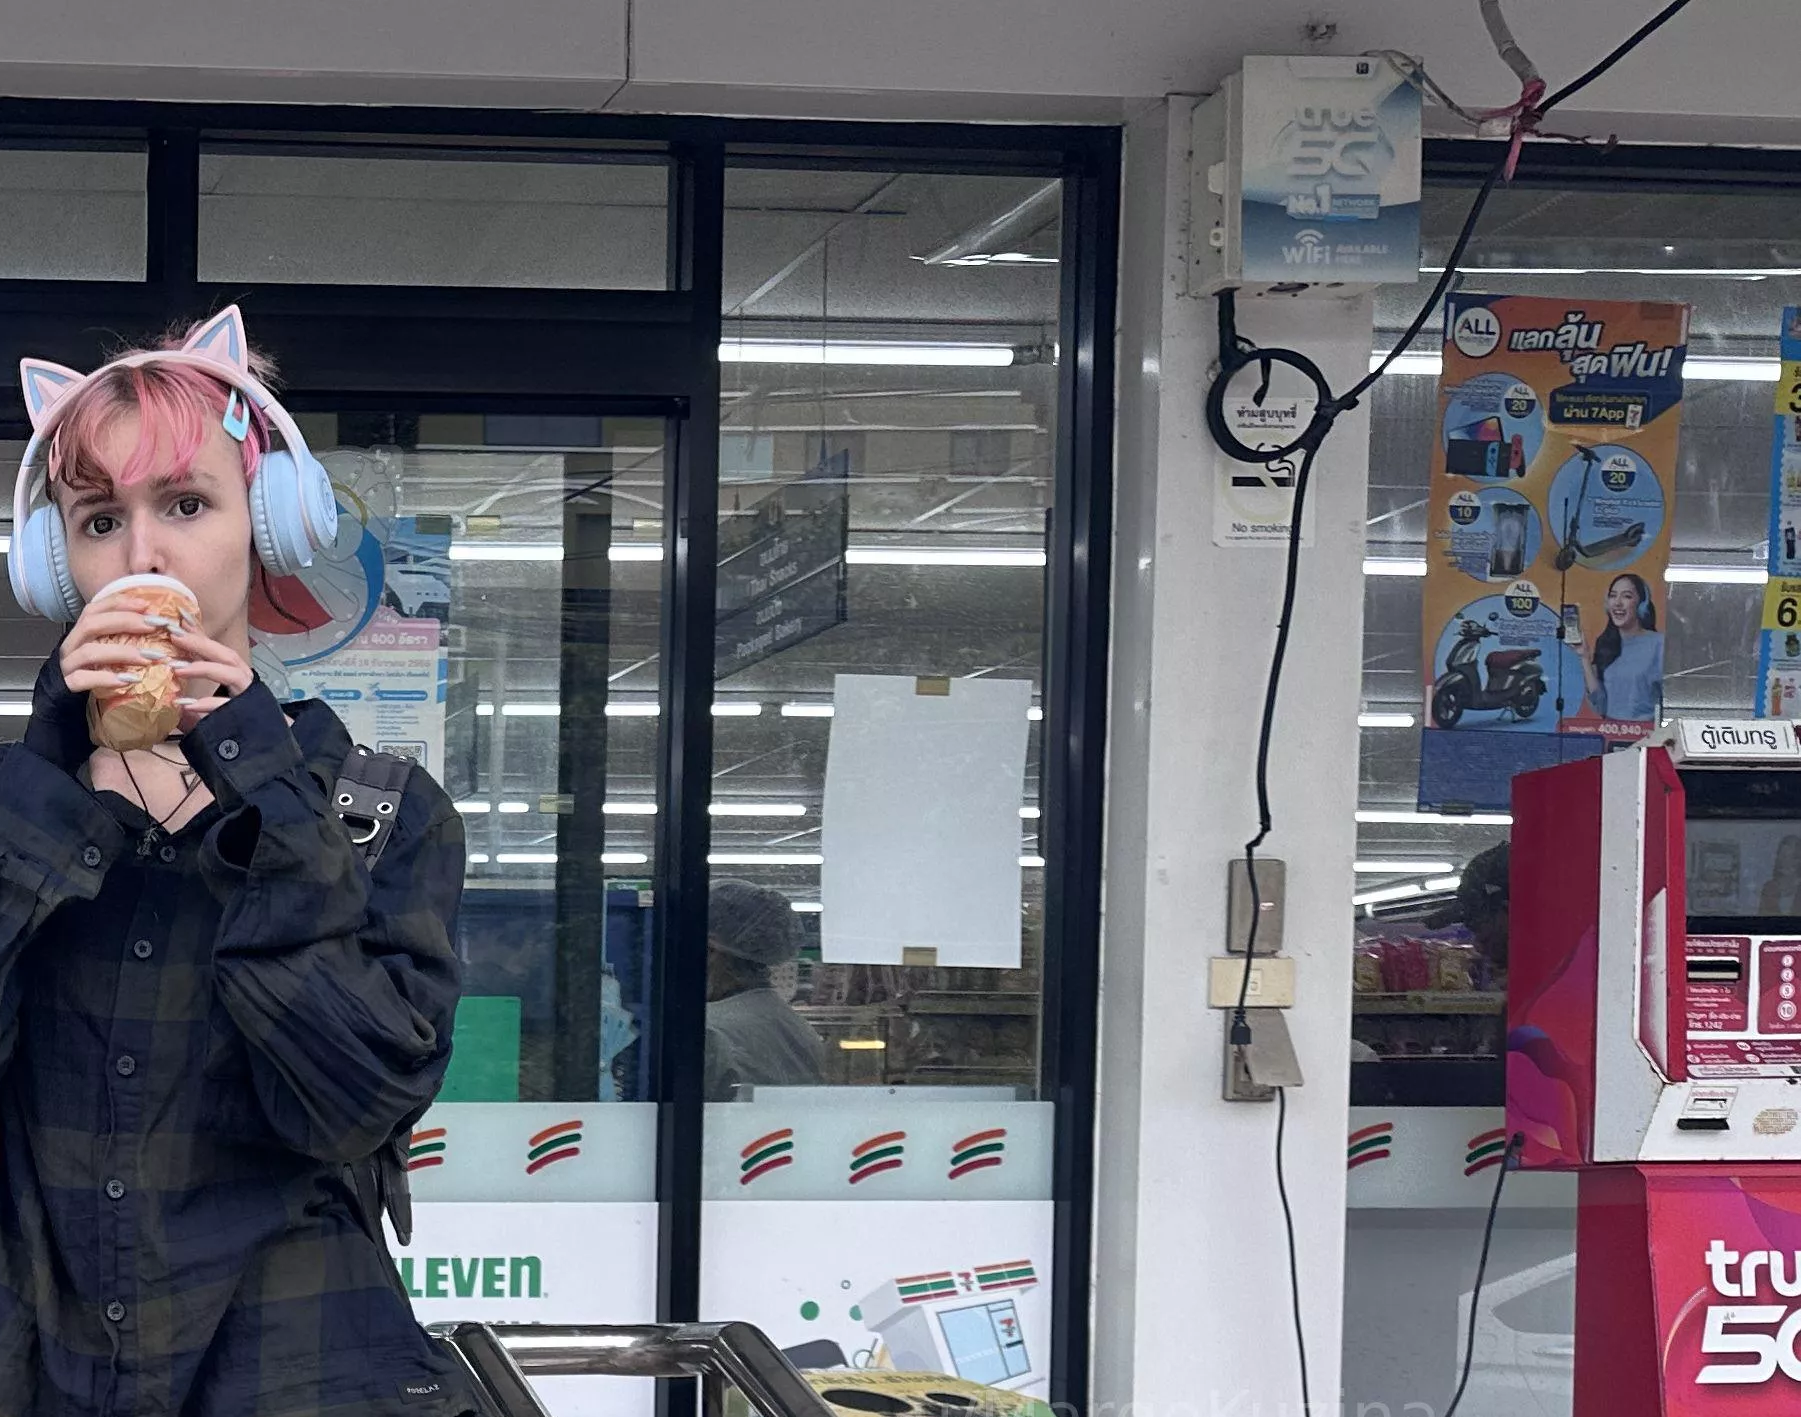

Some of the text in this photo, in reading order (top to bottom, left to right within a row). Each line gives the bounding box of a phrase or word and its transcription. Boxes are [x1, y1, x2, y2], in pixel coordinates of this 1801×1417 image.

[1461, 317, 1496, 336] ALL
[1609, 472, 1626, 484] 20
[1457, 507, 1472, 517] 10
[1232, 523, 1248, 533] No
[1511, 597, 1533, 610] 100
[371, 633, 395, 645] 400
[1701, 724, 1778, 750] ตู้เติมทรู
[1782, 1006, 1793, 1015] 10
